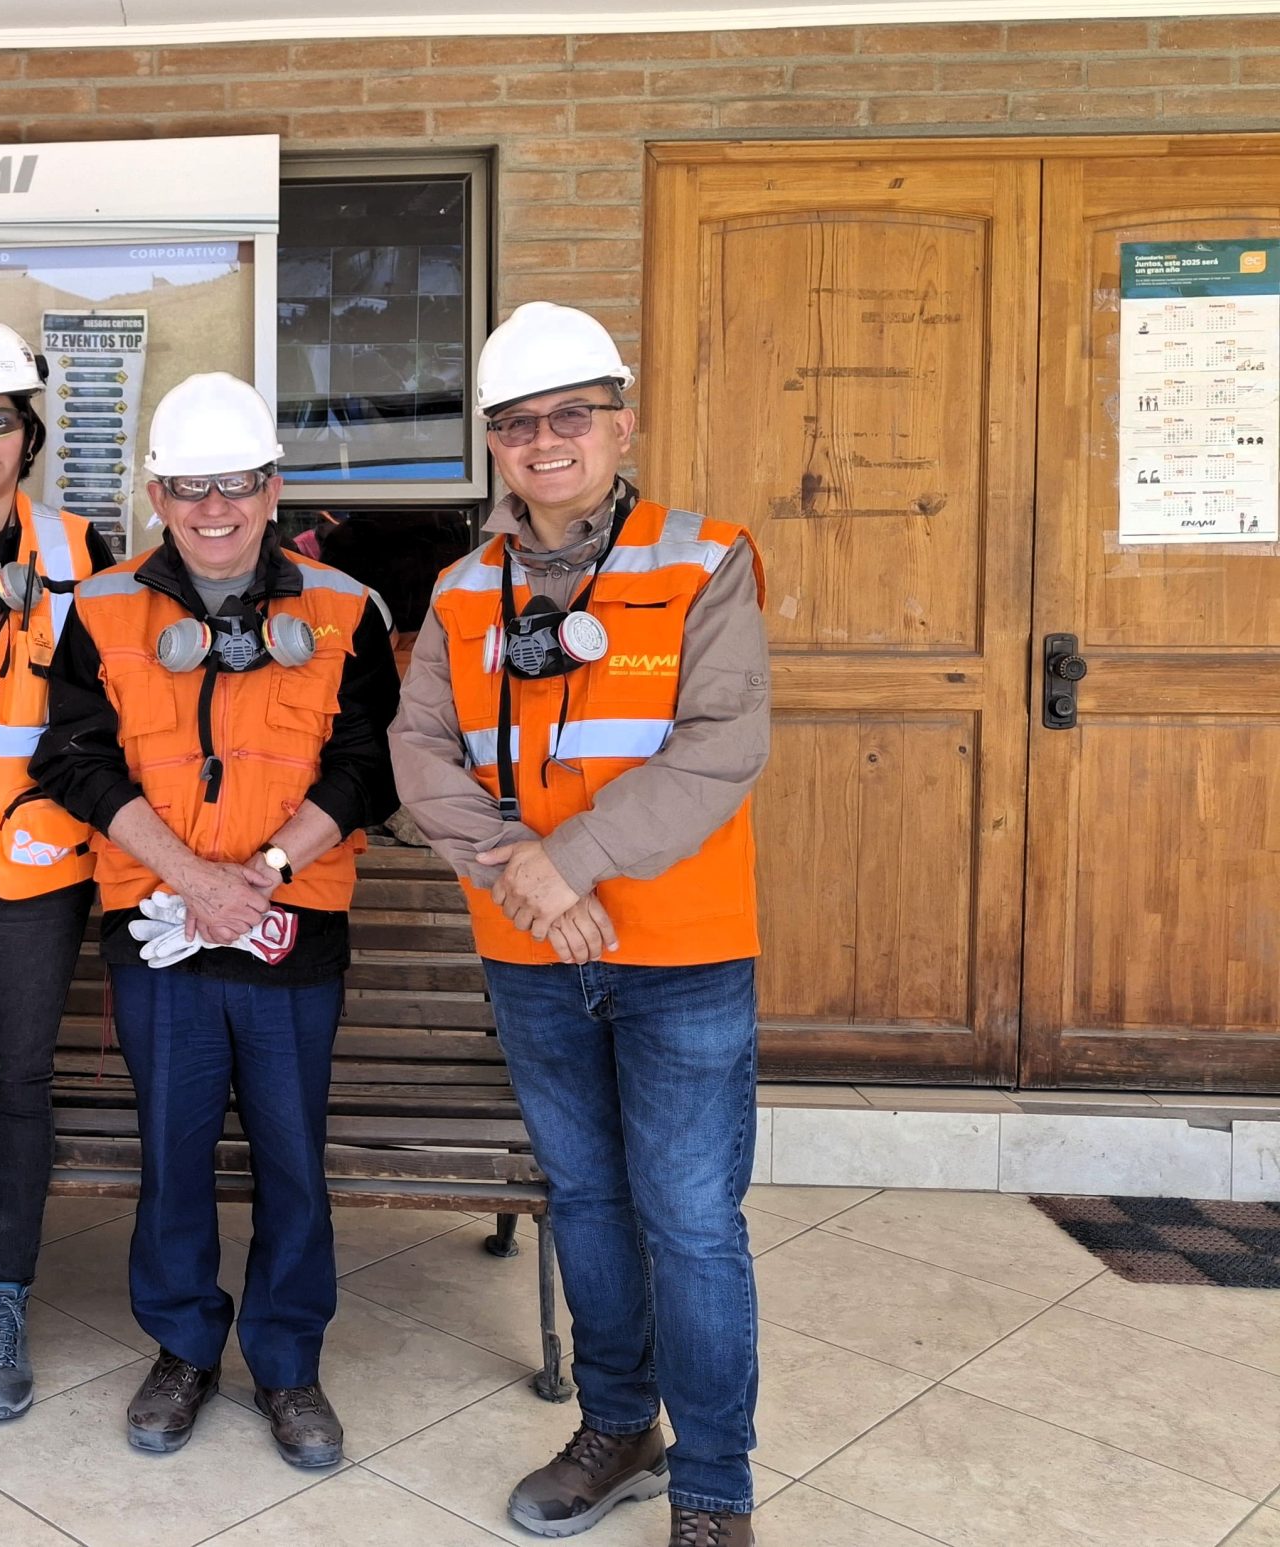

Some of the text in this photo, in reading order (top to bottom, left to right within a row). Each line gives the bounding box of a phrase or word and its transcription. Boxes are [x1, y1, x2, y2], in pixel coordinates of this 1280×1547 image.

[129, 246, 227, 260] CORPORATIVO
[46, 333, 143, 348] 12 EVENTOS TOP
[1181, 520, 1216, 528] ENAMI
[608, 655, 678, 671] ENAMI
